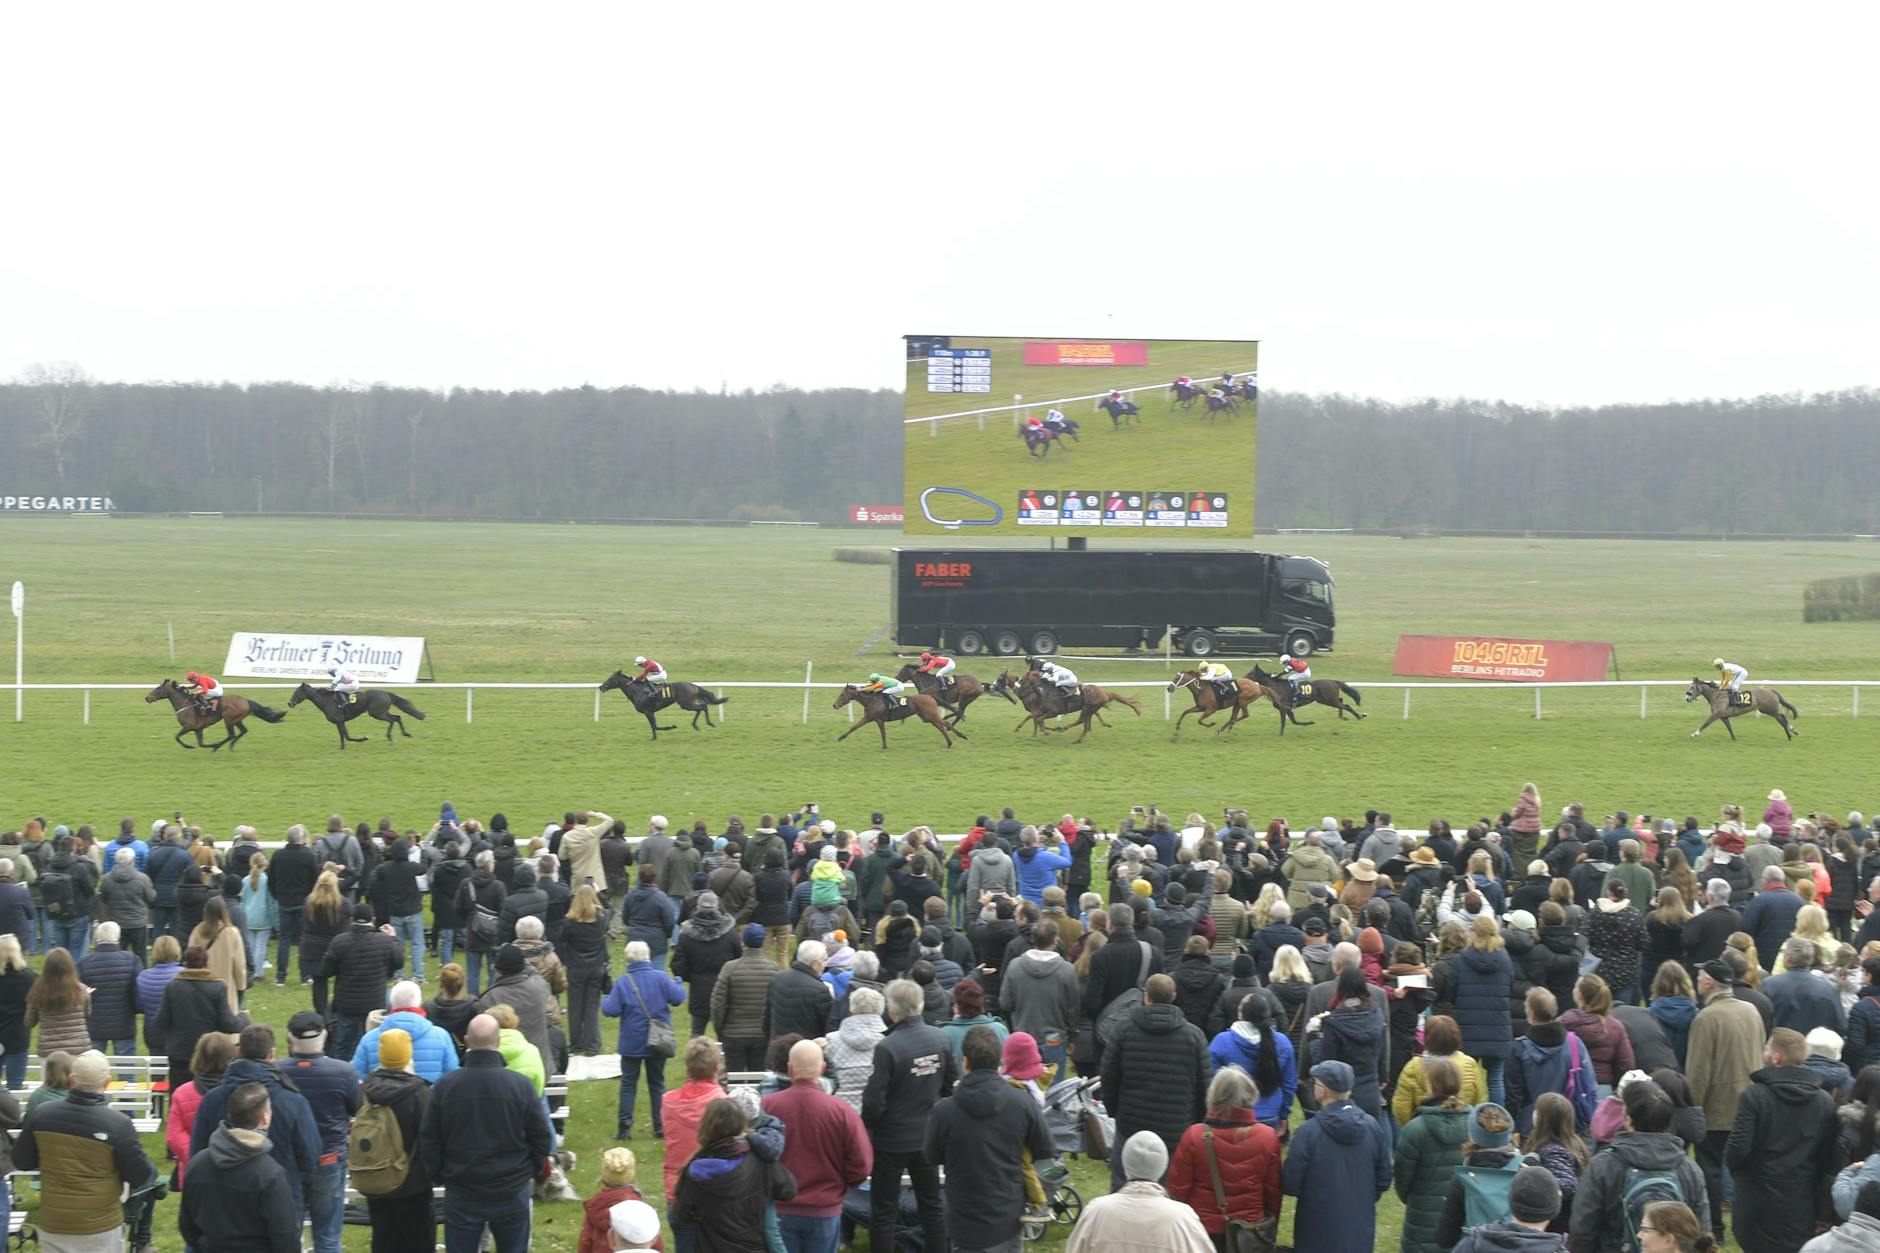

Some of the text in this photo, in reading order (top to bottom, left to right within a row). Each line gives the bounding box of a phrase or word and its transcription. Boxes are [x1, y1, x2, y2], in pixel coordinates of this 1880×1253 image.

[915, 563, 972, 577] FABER
[244, 637, 403, 671] Berliner Zeitung
[1451, 665, 1545, 677] BERLINS HITRADIO
[1300, 684, 1312, 695] 10
[349, 693, 357, 703] 5
[1739, 693, 1751, 704] 12
